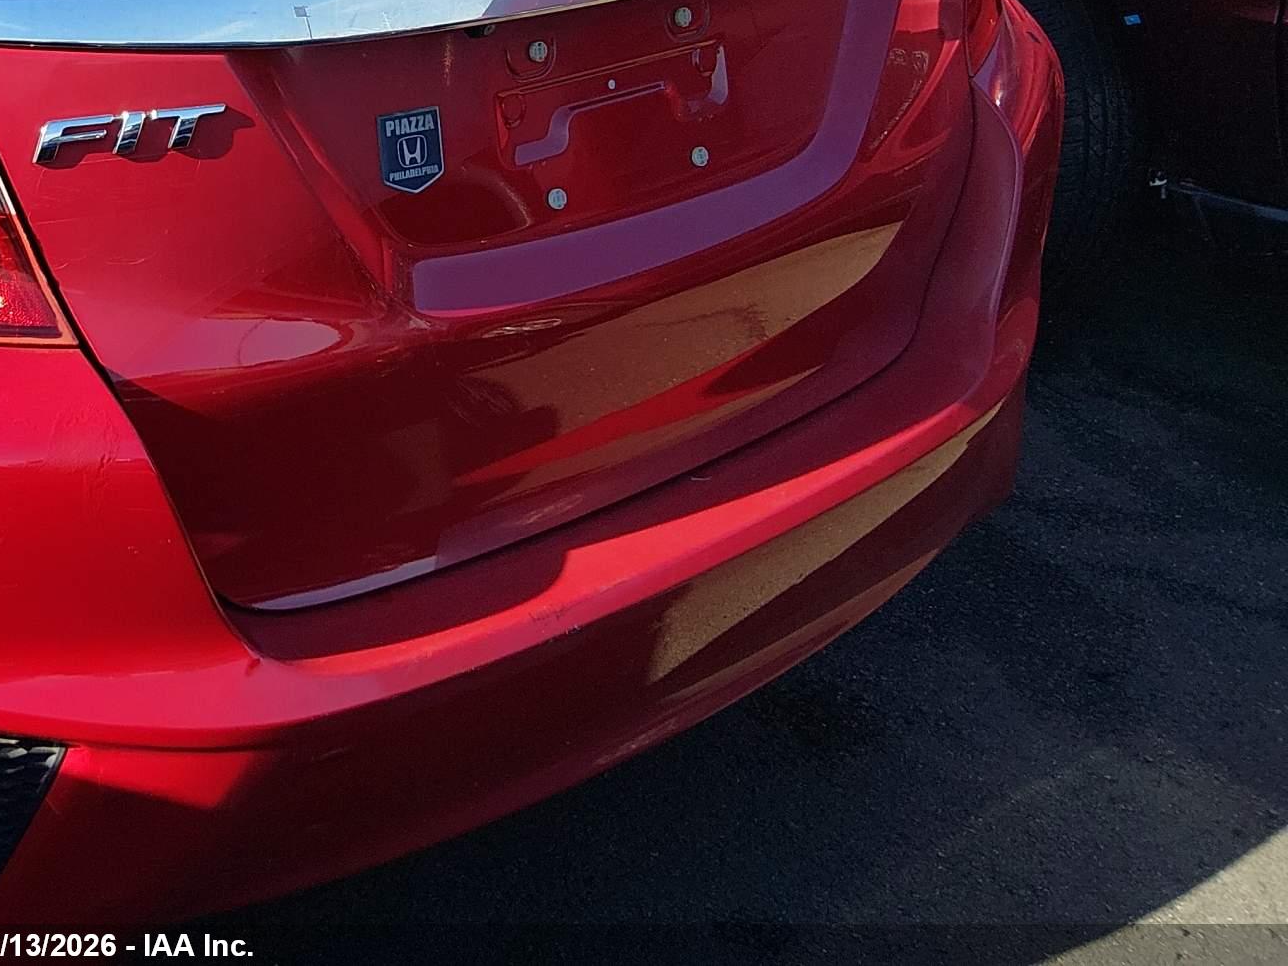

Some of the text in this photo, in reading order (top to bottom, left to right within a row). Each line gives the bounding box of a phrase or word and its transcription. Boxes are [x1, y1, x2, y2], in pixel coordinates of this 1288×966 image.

[32, 103, 227, 165] FIT
[385, 114, 434, 136] PIAZZA
[389, 165, 439, 181] PHILADELPHIA
